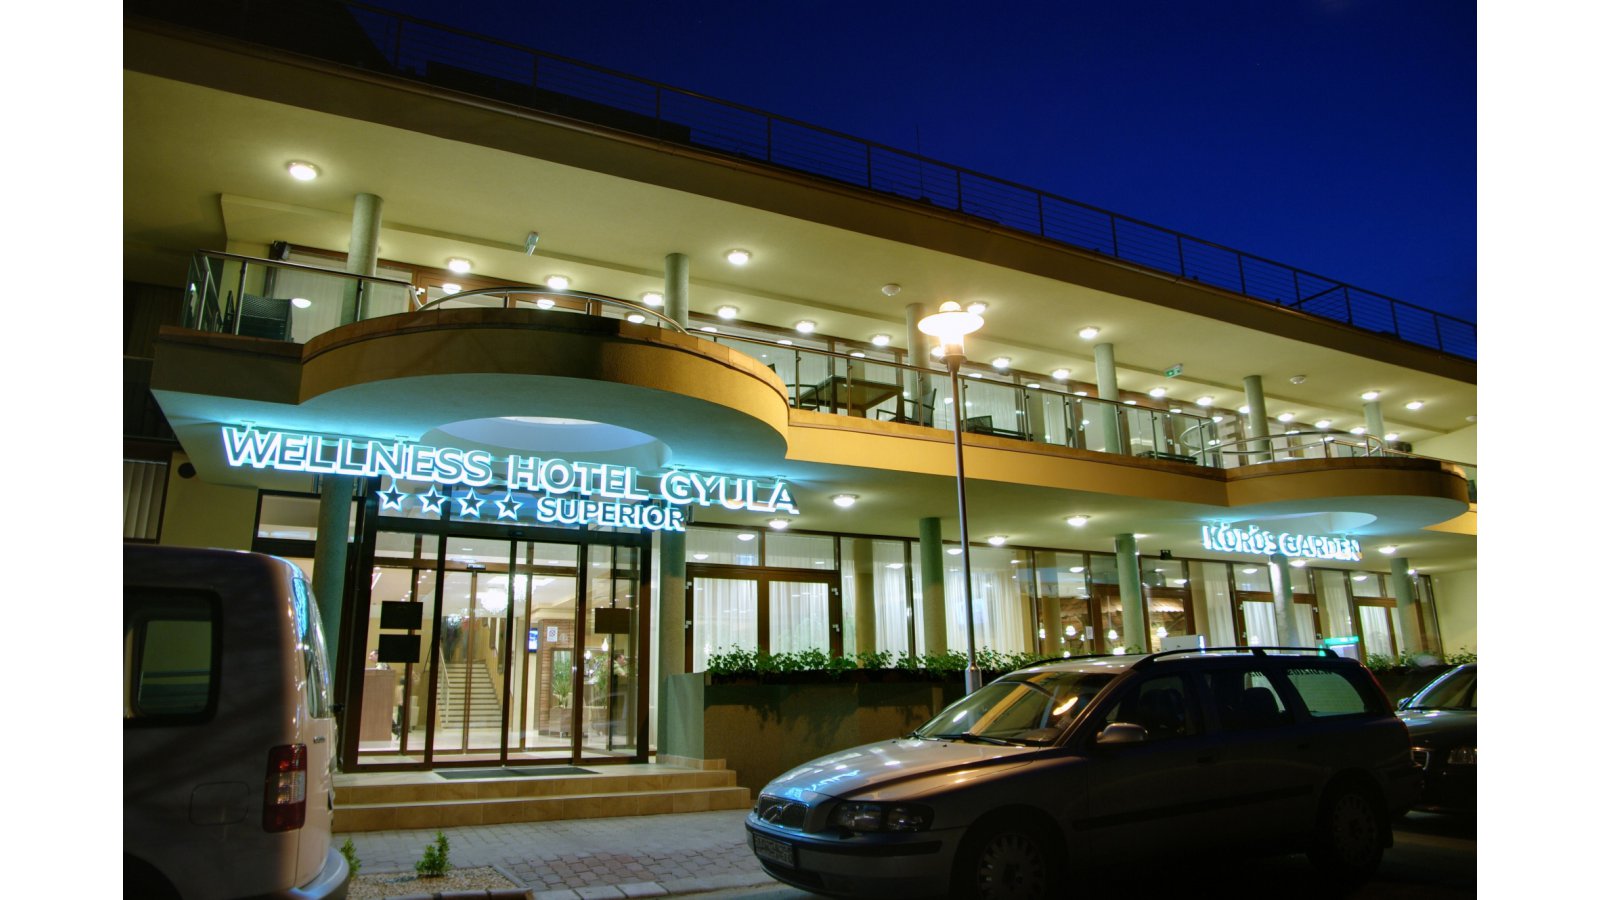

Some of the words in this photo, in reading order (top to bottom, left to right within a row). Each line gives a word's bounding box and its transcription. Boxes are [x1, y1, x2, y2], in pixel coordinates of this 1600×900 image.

[221, 427, 492, 489] WELLNESS
[508, 454, 650, 501] HOTEL
[660, 469, 800, 515] GYULA
[537, 498, 687, 532] SUPERIOR
[1279, 533, 1361, 562] GARDEN
